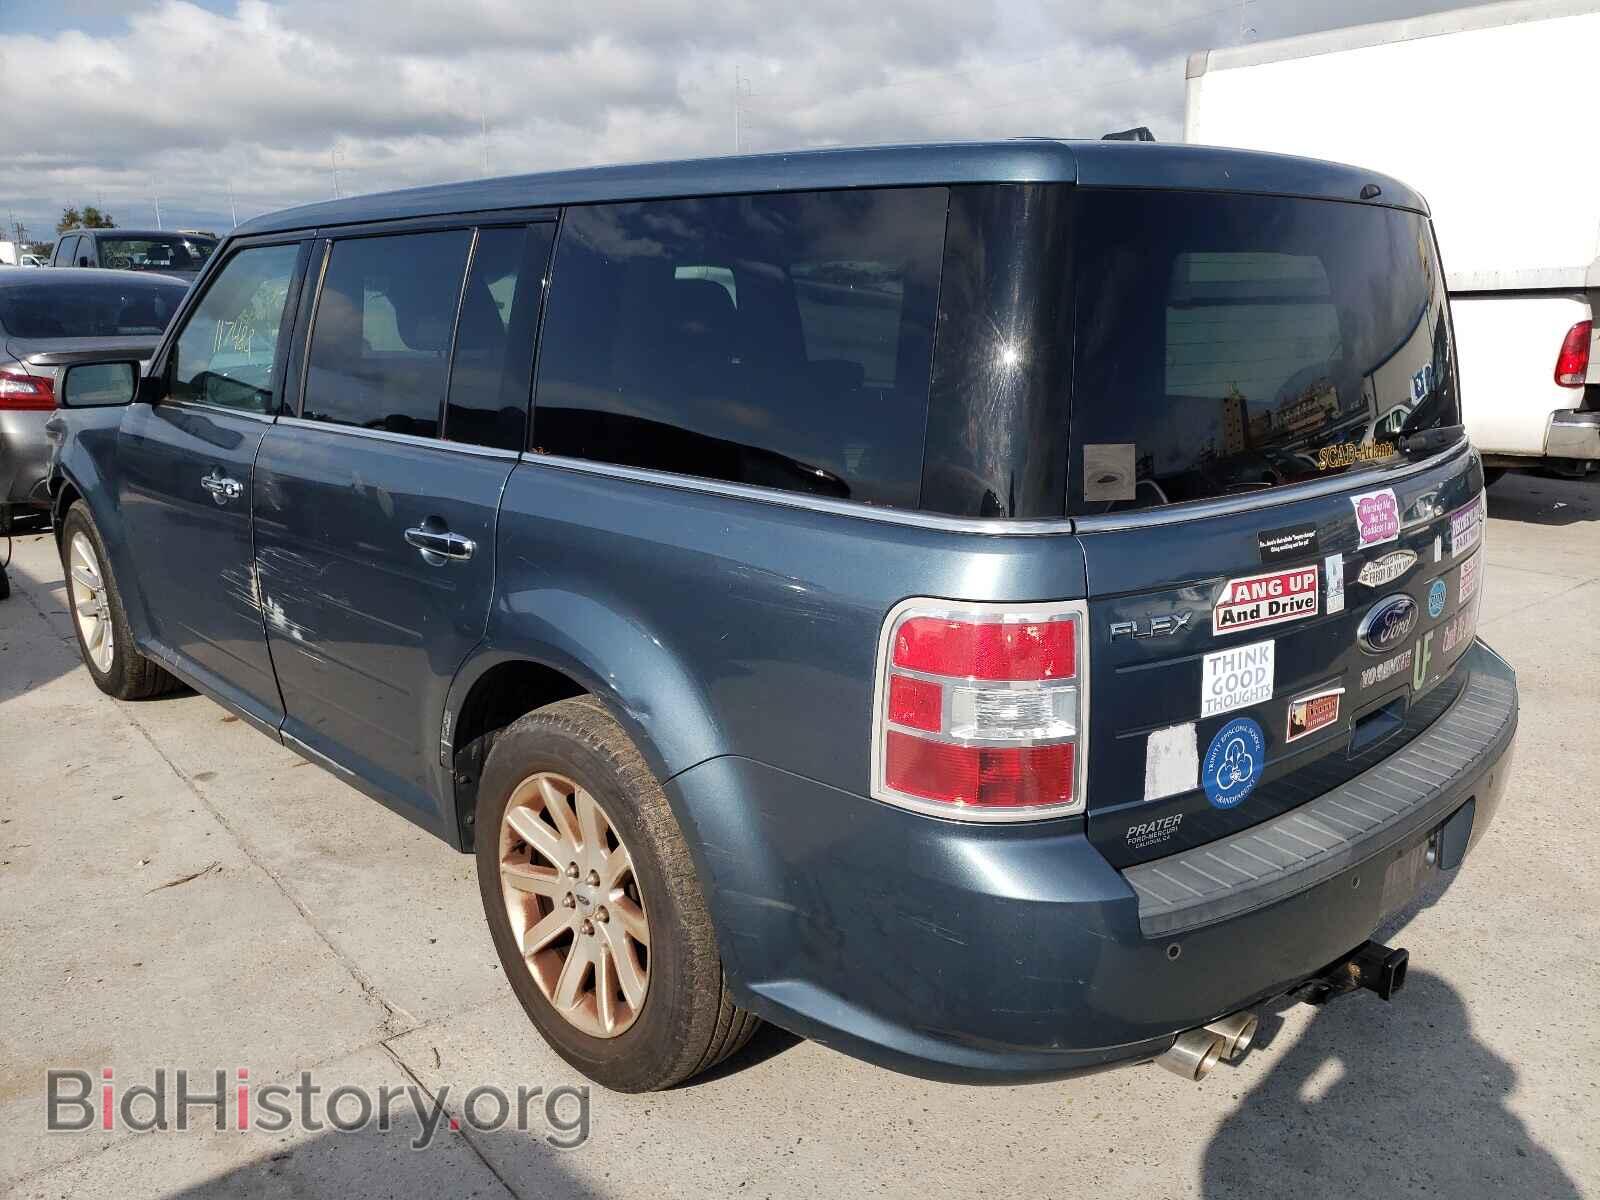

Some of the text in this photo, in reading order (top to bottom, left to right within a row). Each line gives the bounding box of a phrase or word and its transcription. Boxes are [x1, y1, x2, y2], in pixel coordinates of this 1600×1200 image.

[1234, 574, 1315, 603] ANG UP
[1219, 603, 1261, 625] And
[1267, 597, 1314, 617] Drive
[1380, 600, 1412, 643] Ford
[1110, 611, 1193, 643] FLEX
[1208, 646, 1269, 676] THINK
[1212, 667, 1266, 696] GOOD
[1204, 684, 1271, 713] THOUGHTS
[1208, 742, 1221, 773] TRINITY
[1126, 813, 1184, 839] PRATER
